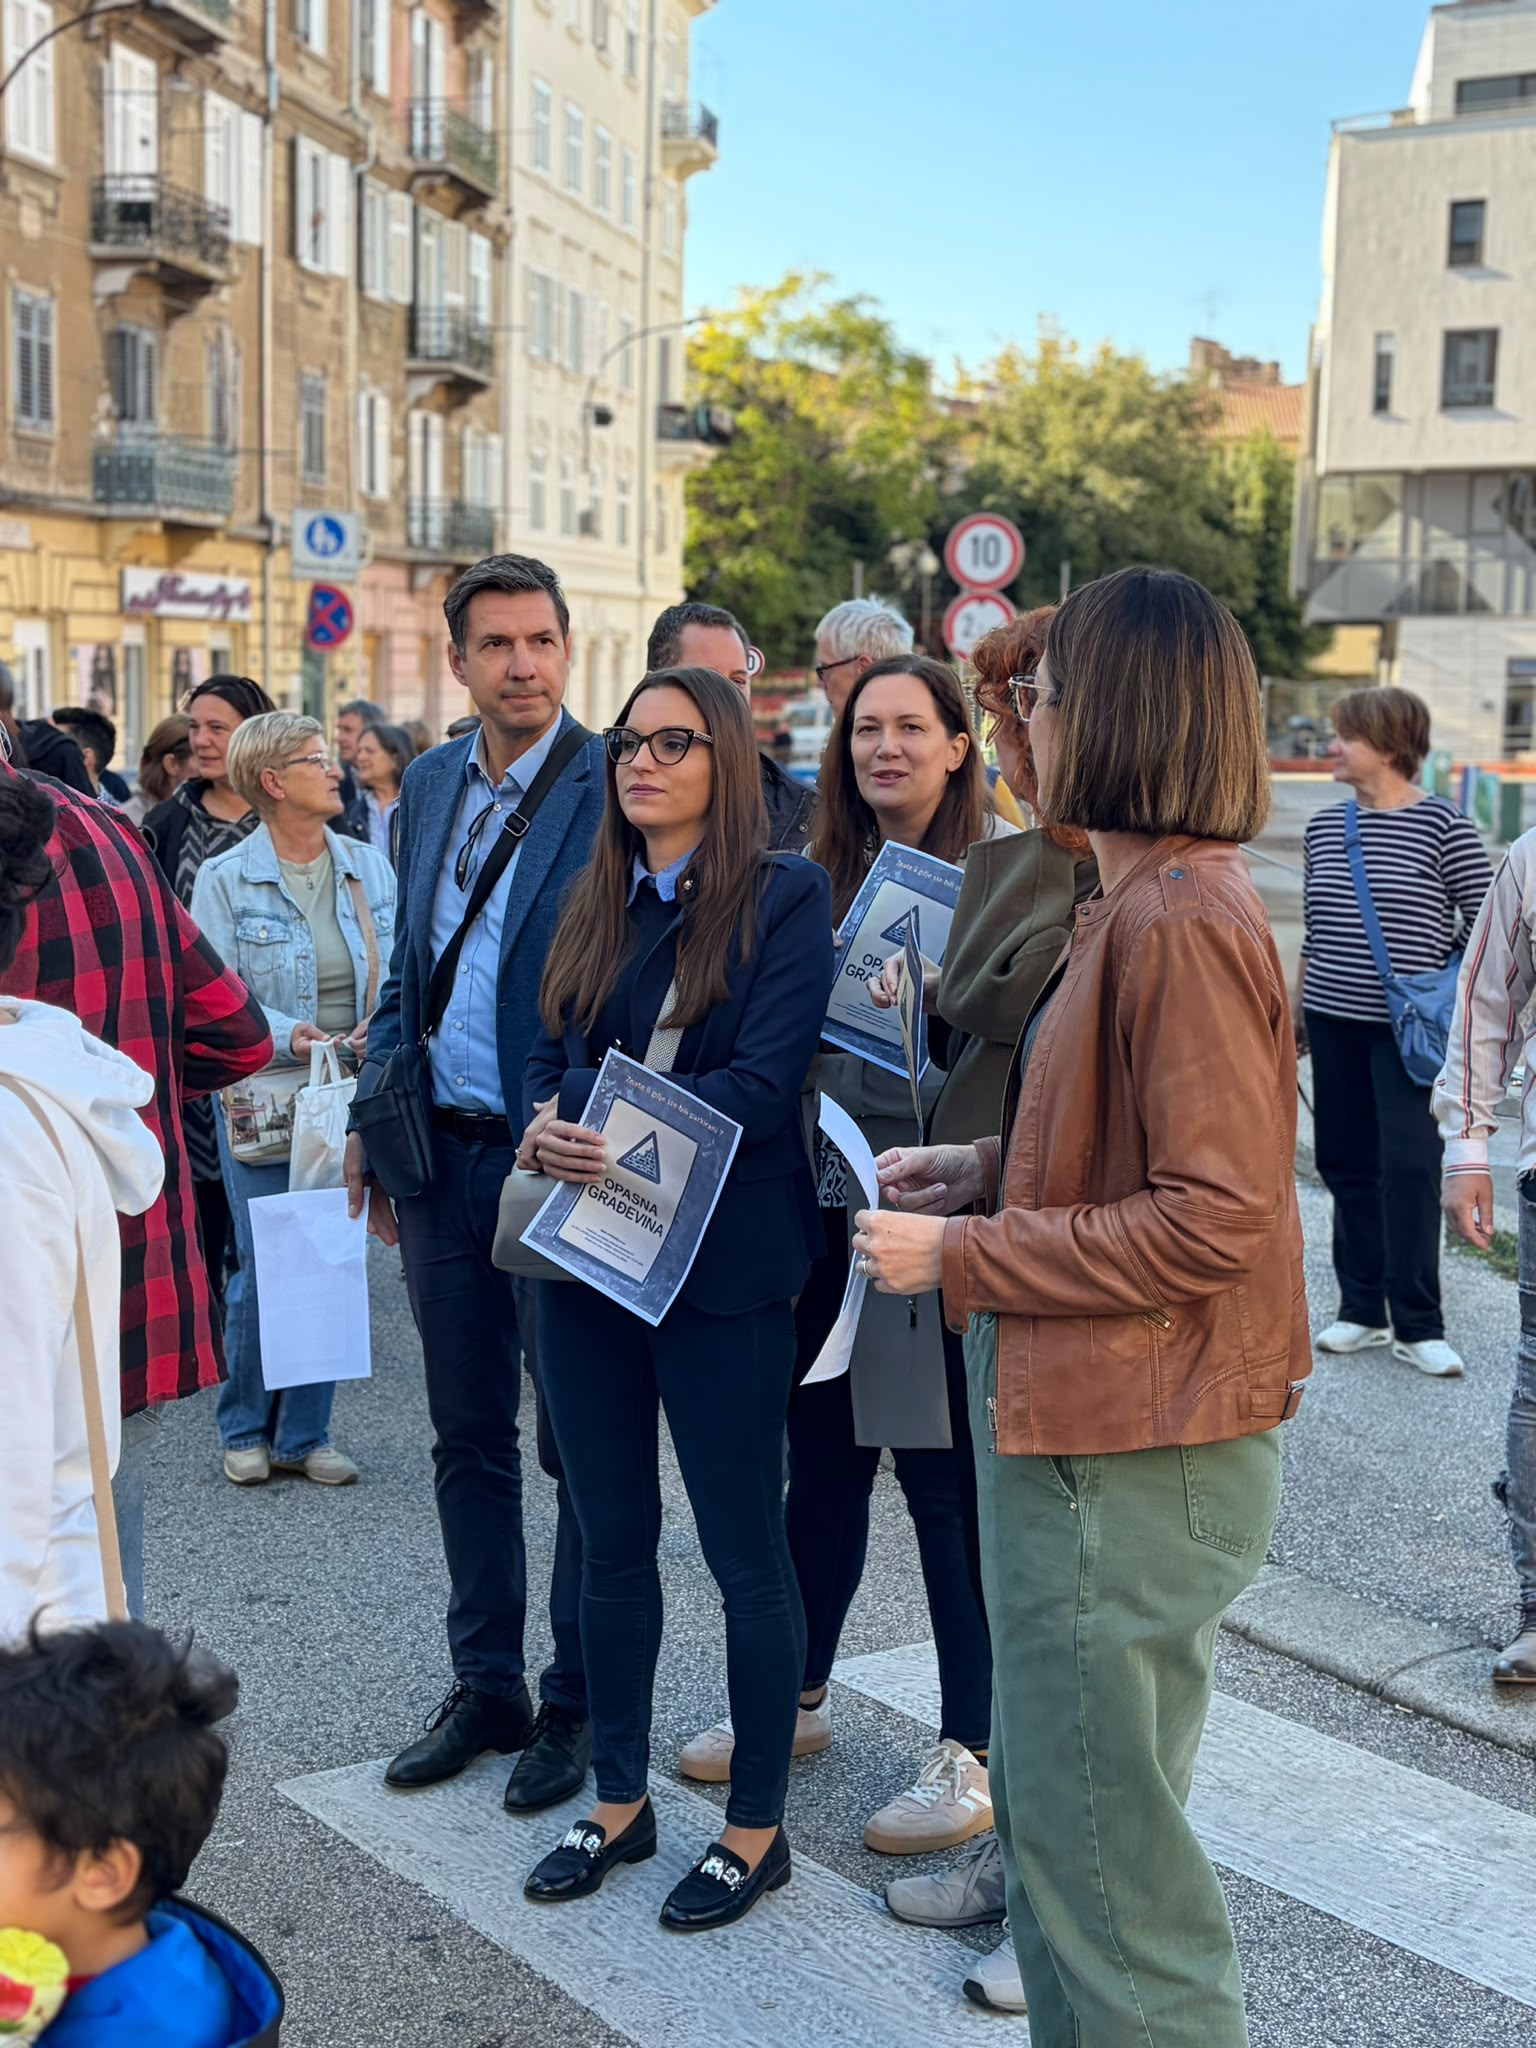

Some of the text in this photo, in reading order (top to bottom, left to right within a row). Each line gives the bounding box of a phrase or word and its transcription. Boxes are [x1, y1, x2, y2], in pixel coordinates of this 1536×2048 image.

[971, 533, 1002, 569] 10
[625, 1075, 645, 1092] Znate
[588, 1184, 664, 1238] GRAĐEVINA
[604, 1178, 658, 1217] OPASNA
